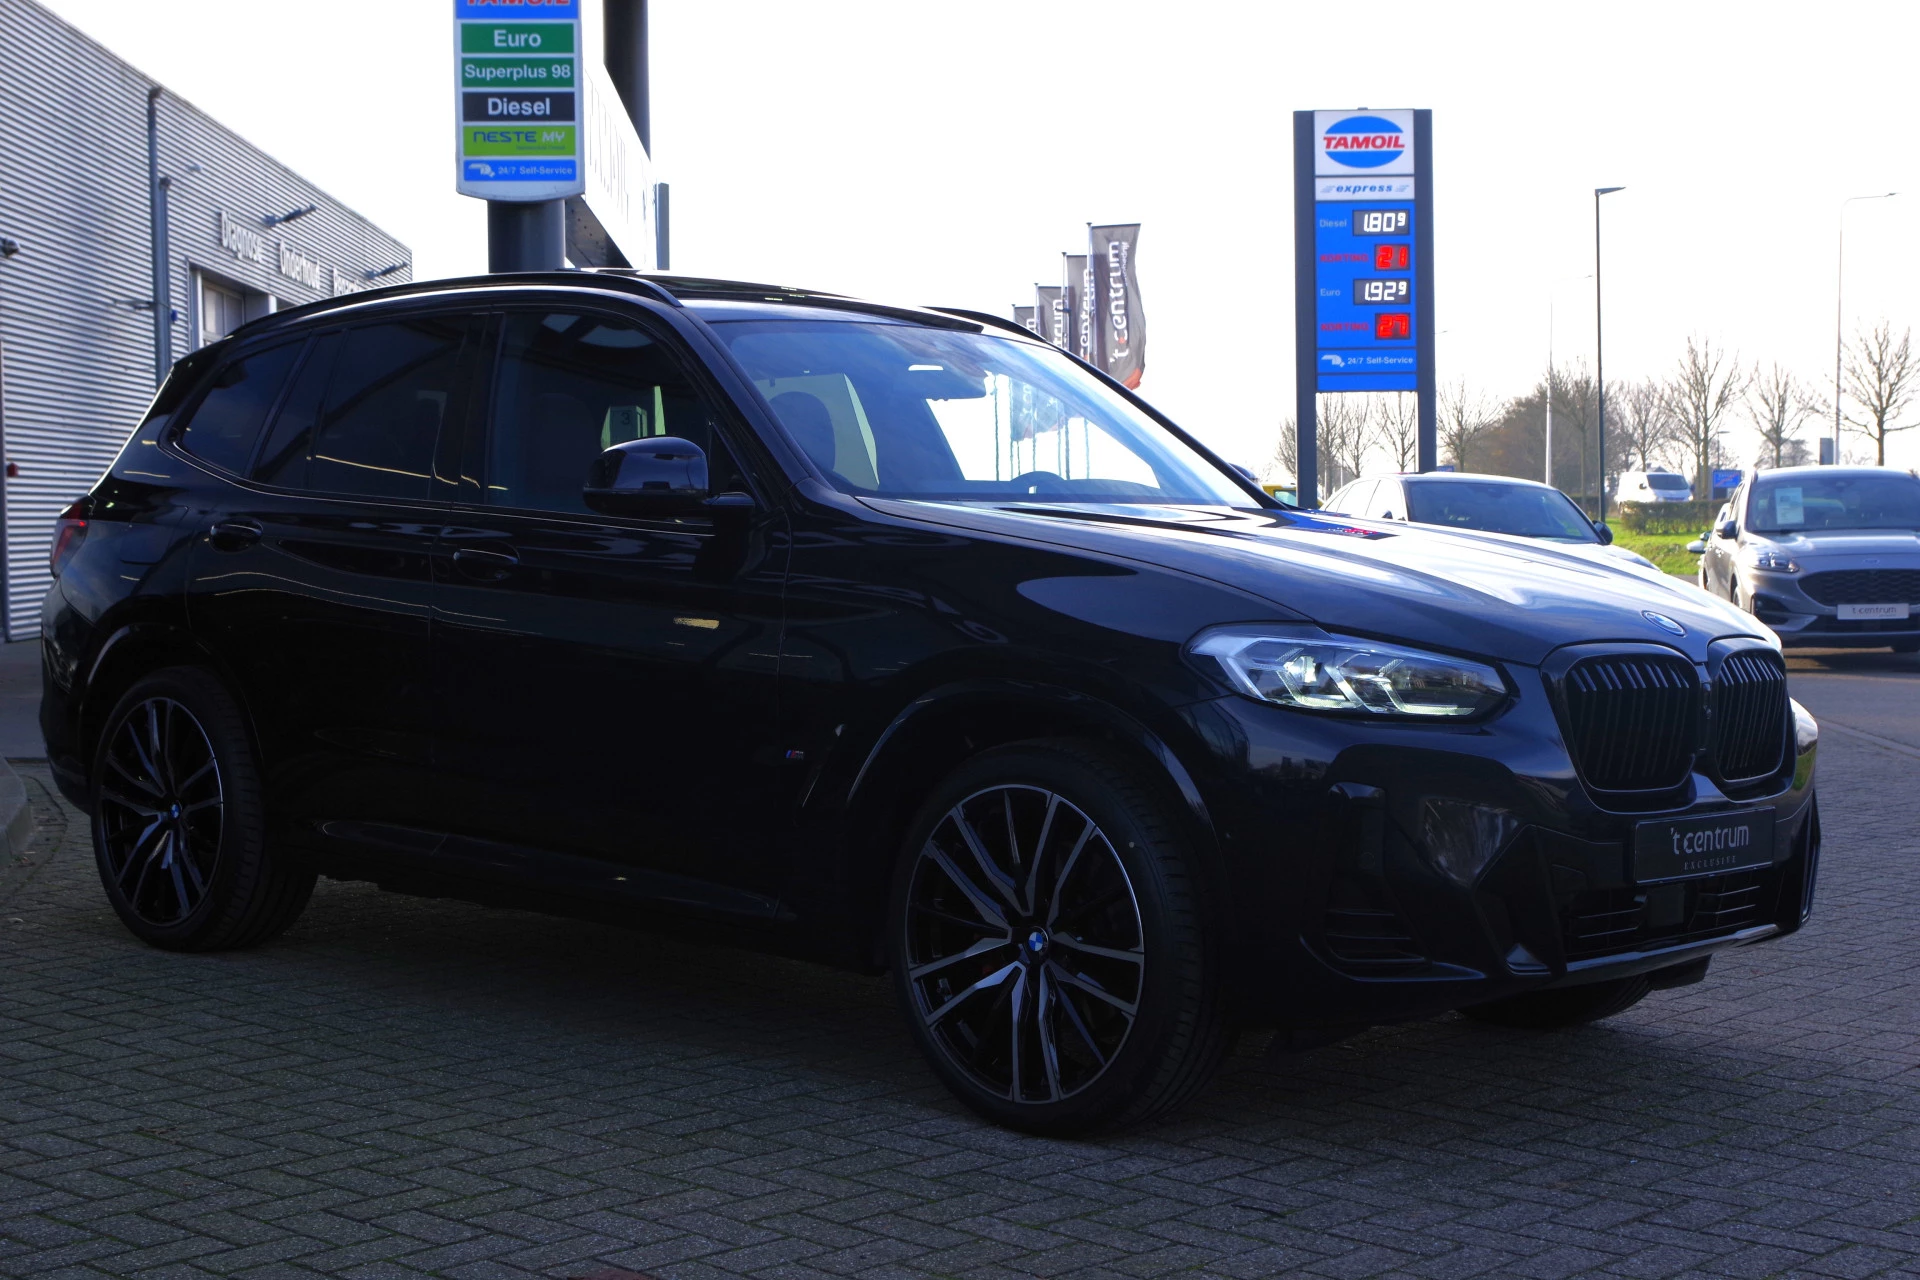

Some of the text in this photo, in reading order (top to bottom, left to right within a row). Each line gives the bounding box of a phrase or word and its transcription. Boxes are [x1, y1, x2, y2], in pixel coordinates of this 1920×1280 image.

[494, 29, 542, 47] Euro
[464, 64, 571, 81] Superplus 98
[487, 97, 551, 115] Diesel
[473, 131, 566, 143] NESTE MY
[1323, 135, 1405, 150] TAMOIL
[498, 166, 572, 175] 24/7 Self-Service
[1336, 184, 1393, 194] express
[1319, 218, 1347, 228] Diesel
[221, 210, 263, 263] Diagnose
[1376, 245, 1408, 268] 21
[1108, 240, 1129, 344] centrum
[1320, 288, 1341, 297] Euro
[1377, 313, 1409, 338] 27
[1347, 356, 1413, 365] 24/7 Self-Service
[1858, 606, 1897, 615] centrum
[1683, 825, 1749, 854] centrum
[1684, 855, 1736, 870] EXCLUSIVE
